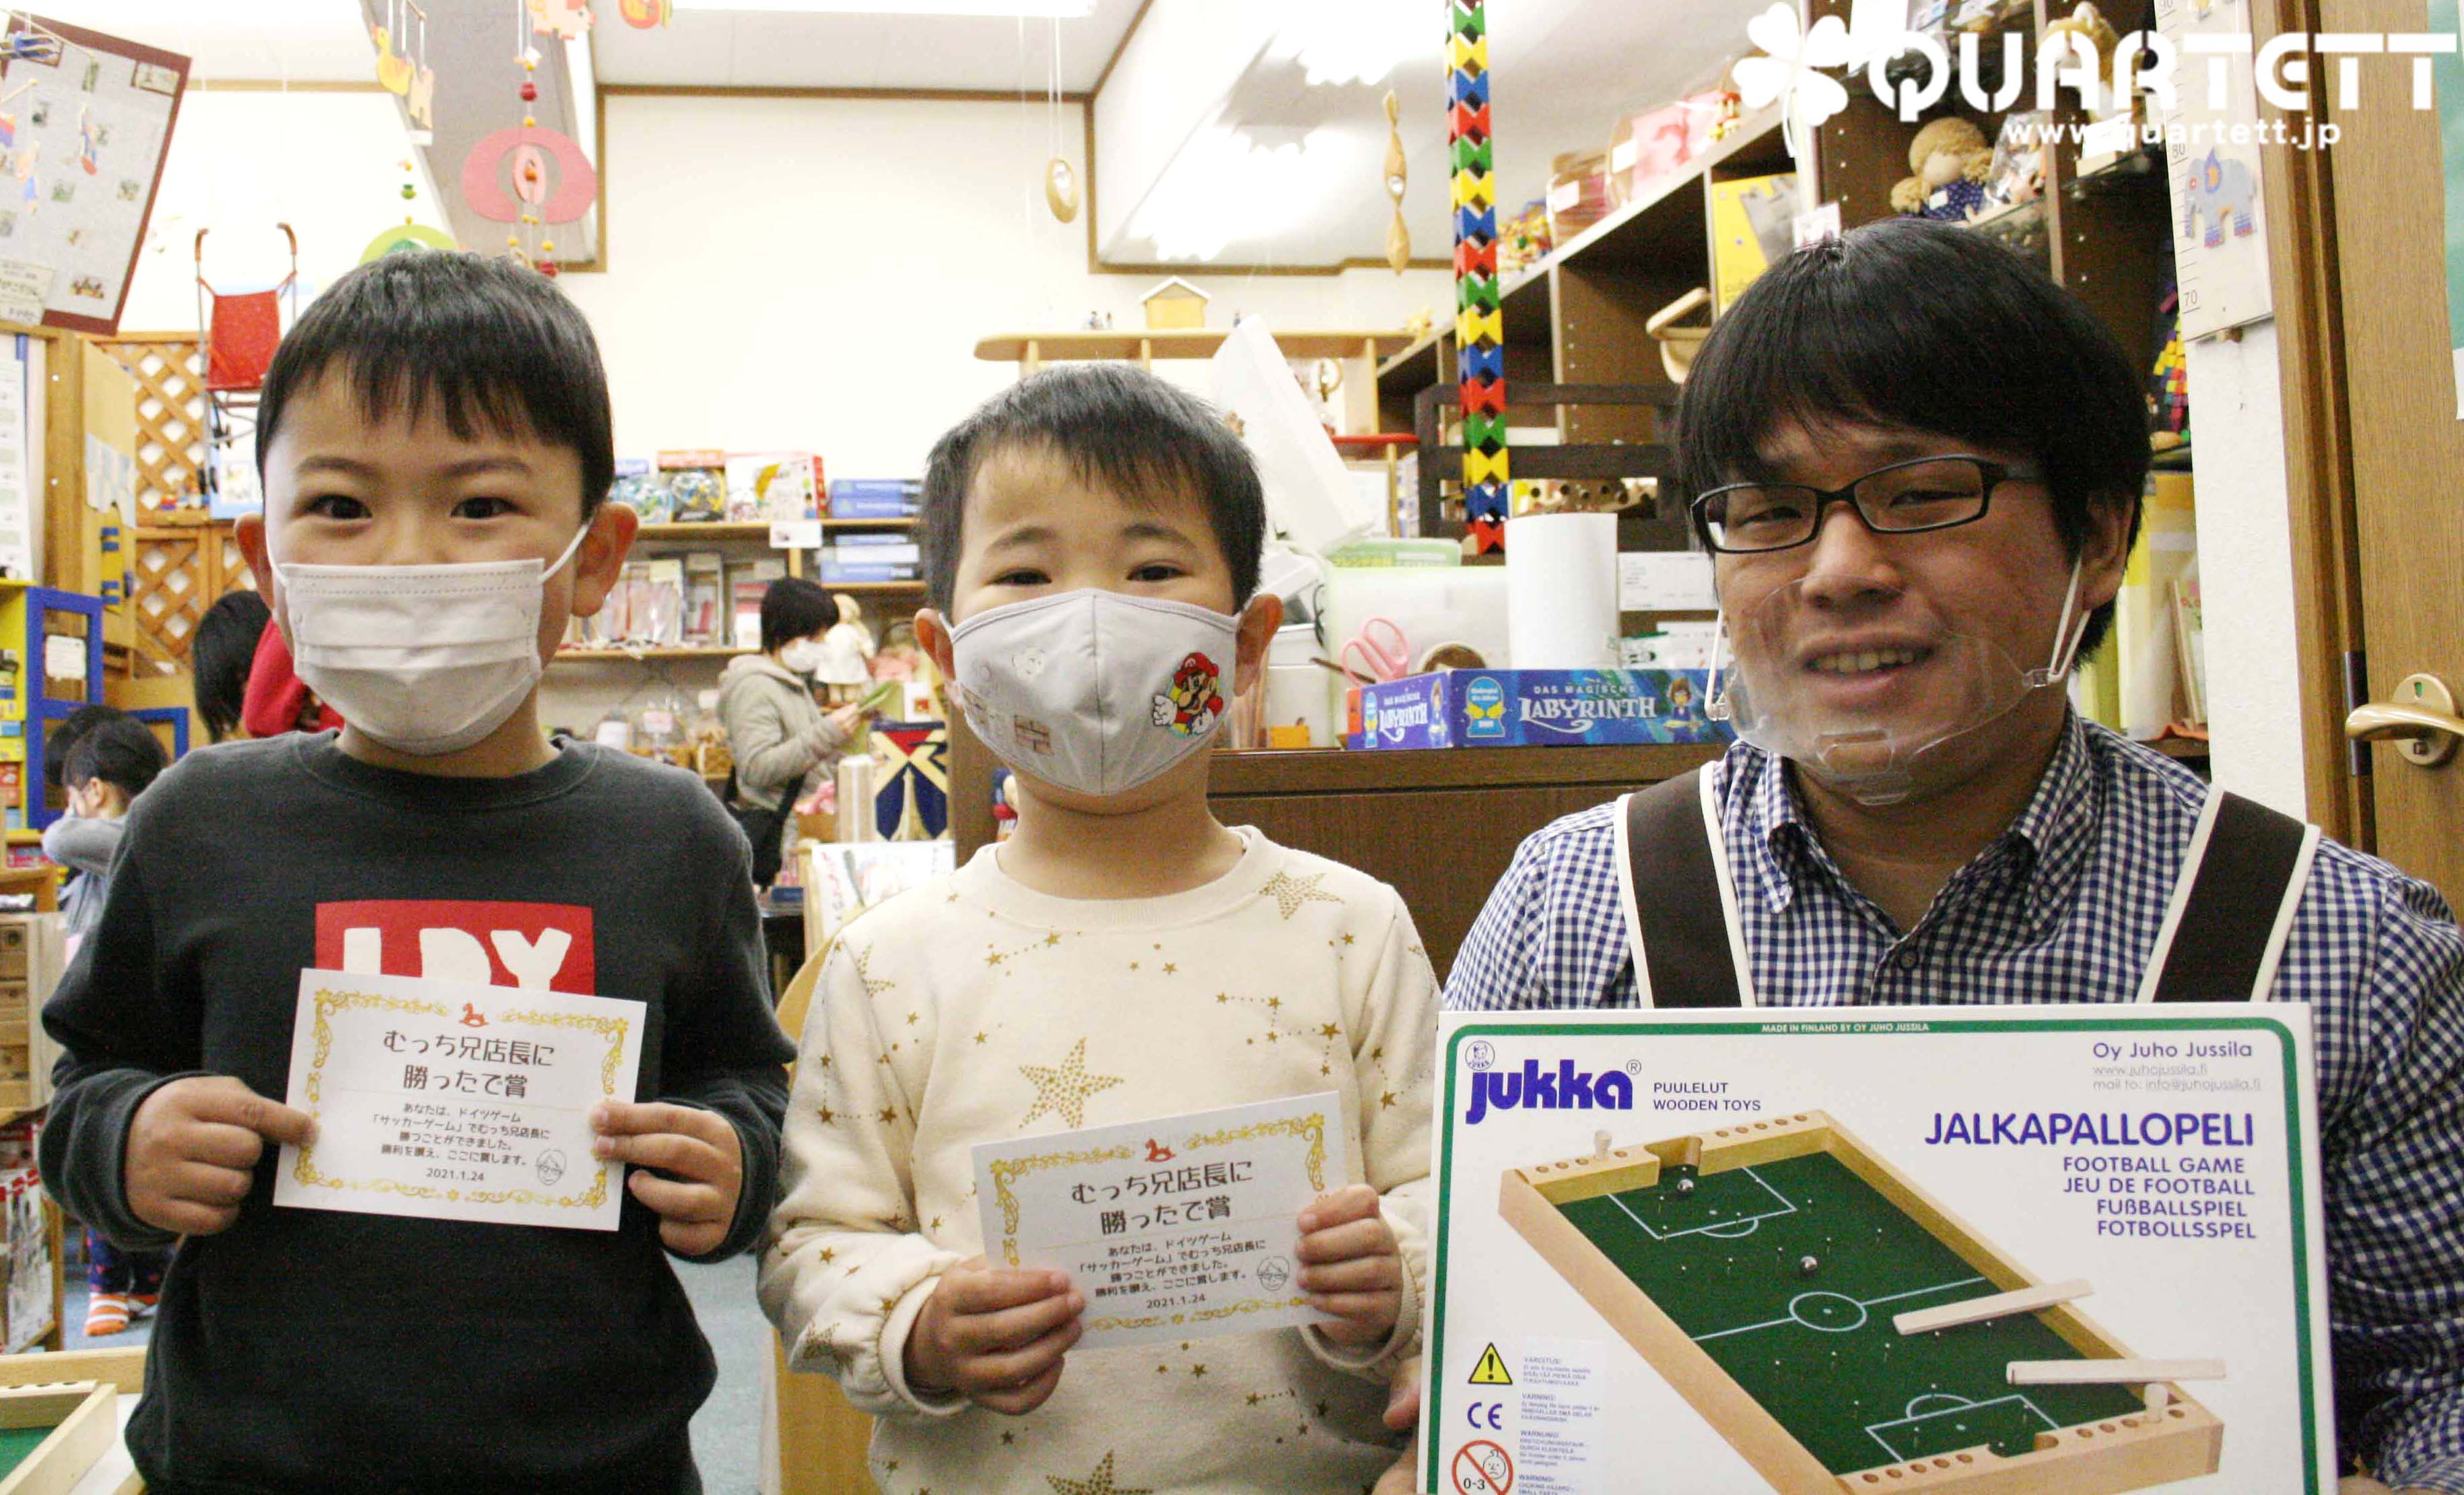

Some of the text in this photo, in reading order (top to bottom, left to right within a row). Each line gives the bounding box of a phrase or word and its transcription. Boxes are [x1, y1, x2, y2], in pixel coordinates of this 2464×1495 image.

[2183, 290, 2198, 307] 70
[1534, 684, 1636, 695] DAS MAGISCHE
[1379, 702, 1429, 743] LABYRINTH
[1517, 696, 1657, 734] LABYRINTH
[1762, 1022, 1929, 1033] MADE IN FINLAND BY OY JUHO JUSSILA
[383, 1028, 555, 1067] むっち兄店長に
[2093, 1041, 2253, 1061] Oy Juho Jussila
[2093, 1063, 2208, 1077] www.juhojussila.fi
[403, 1063, 528, 1099] 勝ったで賞
[1653, 1082, 1728, 1094] PUULELUT
[2093, 1077, 2261, 1092] mail to: info@juhojussila.fi
[1466, 1059, 1633, 1125] jukka
[404, 1102, 522, 1123] あなたは、ドイツゲーム
[1653, 1099, 1761, 1111] WOODEN TOYS
[373, 1113, 552, 1140] 「サッカーゲーム」でむっち兄店長に
[1925, 1112, 2254, 1145] JALKAPALLOPELI
[2063, 1156, 2245, 1173] FOOTBALL GAME
[425, 1167, 485, 1182] 2021.1.24
[1072, 1160, 1254, 1204] むっち兄店長に
[2063, 1177, 2255, 1195] JEU DE FOOTBALL
[1100, 1195, 1231, 1236] 勝ったで賞
[2097, 1199, 2247, 1217] FUßBALLSPIEL
[2097, 1220, 2257, 1238] FOTBOLLSSPEL
[1108, 1231, 1231, 1258] あなたは、ドイツゲーム
[1080, 1239, 1266, 1273] 「サッカーゲーム」でむっち兄店長に
[1147, 1293, 1206, 1309] 2021.1.24
[1464, 1477, 1485, 1490] 0-3
